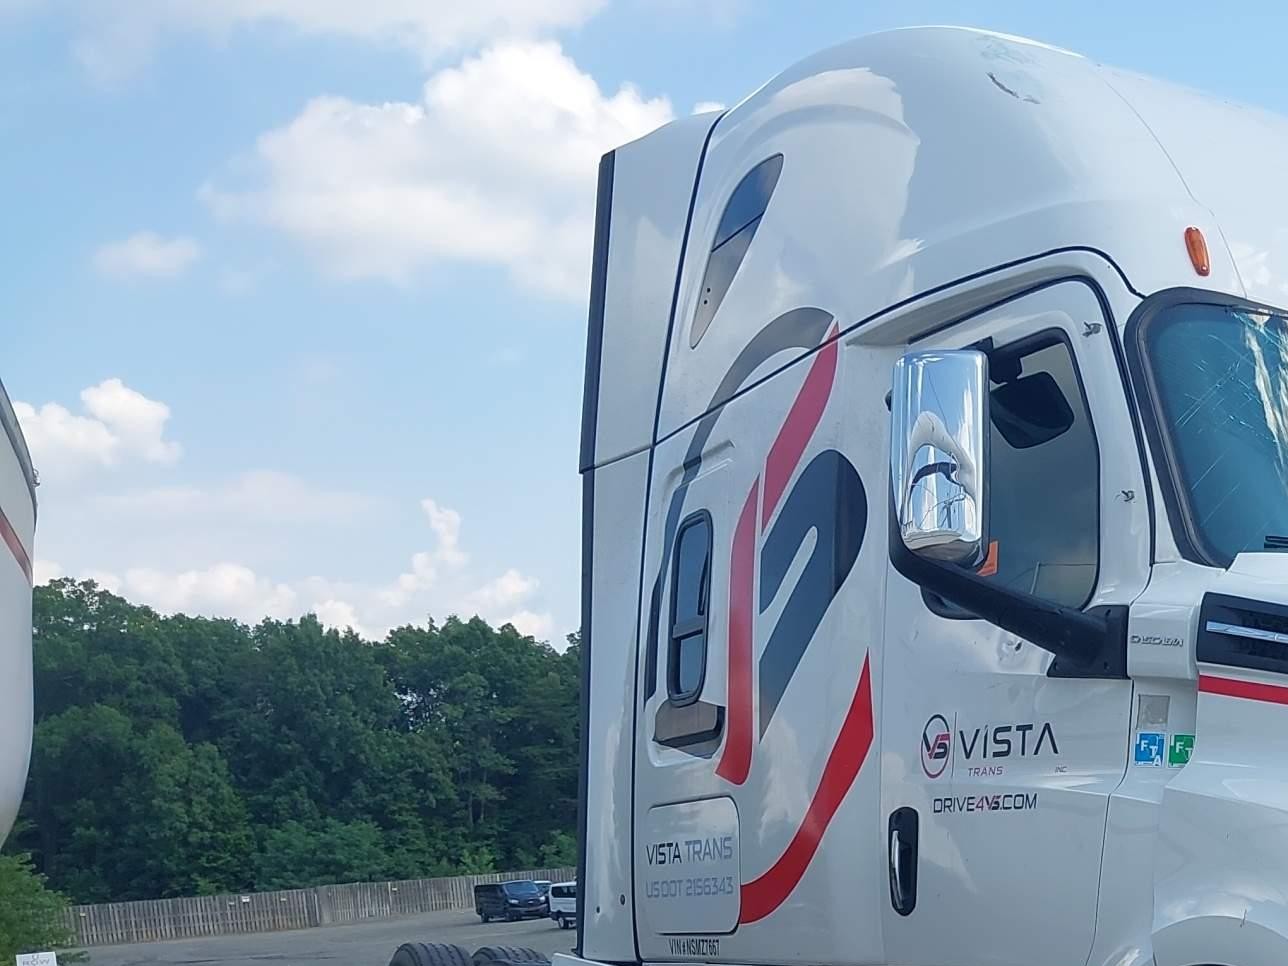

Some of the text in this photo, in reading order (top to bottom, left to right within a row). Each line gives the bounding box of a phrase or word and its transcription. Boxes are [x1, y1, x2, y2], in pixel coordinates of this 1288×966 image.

[958, 721, 1060, 760] VISTA
[967, 765, 1004, 778] TRANS
[646, 837, 733, 865] VISTA TRANS
[685, 876, 734, 896] 2156343
